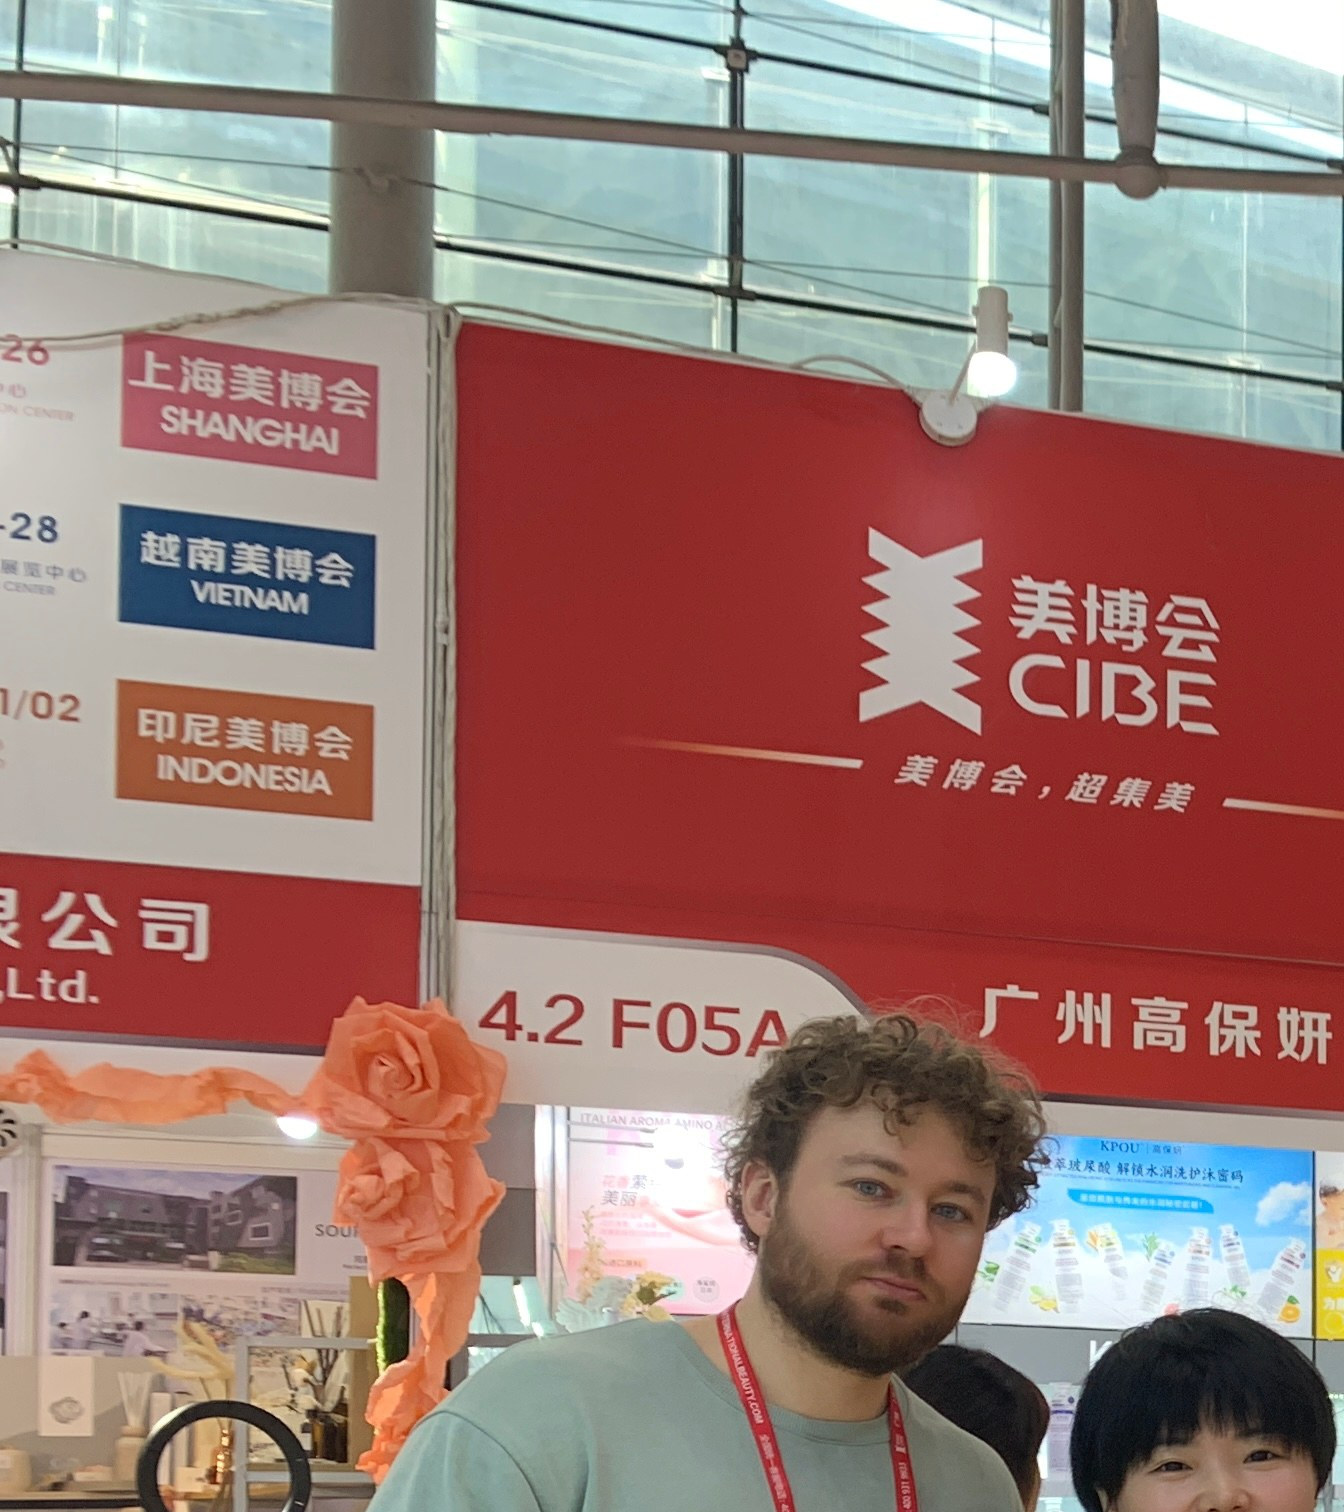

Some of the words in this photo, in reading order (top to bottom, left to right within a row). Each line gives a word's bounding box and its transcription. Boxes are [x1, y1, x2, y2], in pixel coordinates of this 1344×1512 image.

[128, 350, 372, 419] 上海美博会
[160, 405, 340, 456] SHANGHAI
[140, 530, 354, 588] 越南美博会
[190, 579, 310, 617] VIETNAM
[1008, 574, 1220, 663] 美博会
[1008, 653, 1220, 736] CIBE
[137, 707, 353, 761] 印尼美博会
[157, 754, 334, 797] INDONESIA
[478, 990, 586, 1048] 4.2
[580, 1112, 627, 1126] ITALIAN
[601, 1189, 638, 1207] 美丽
